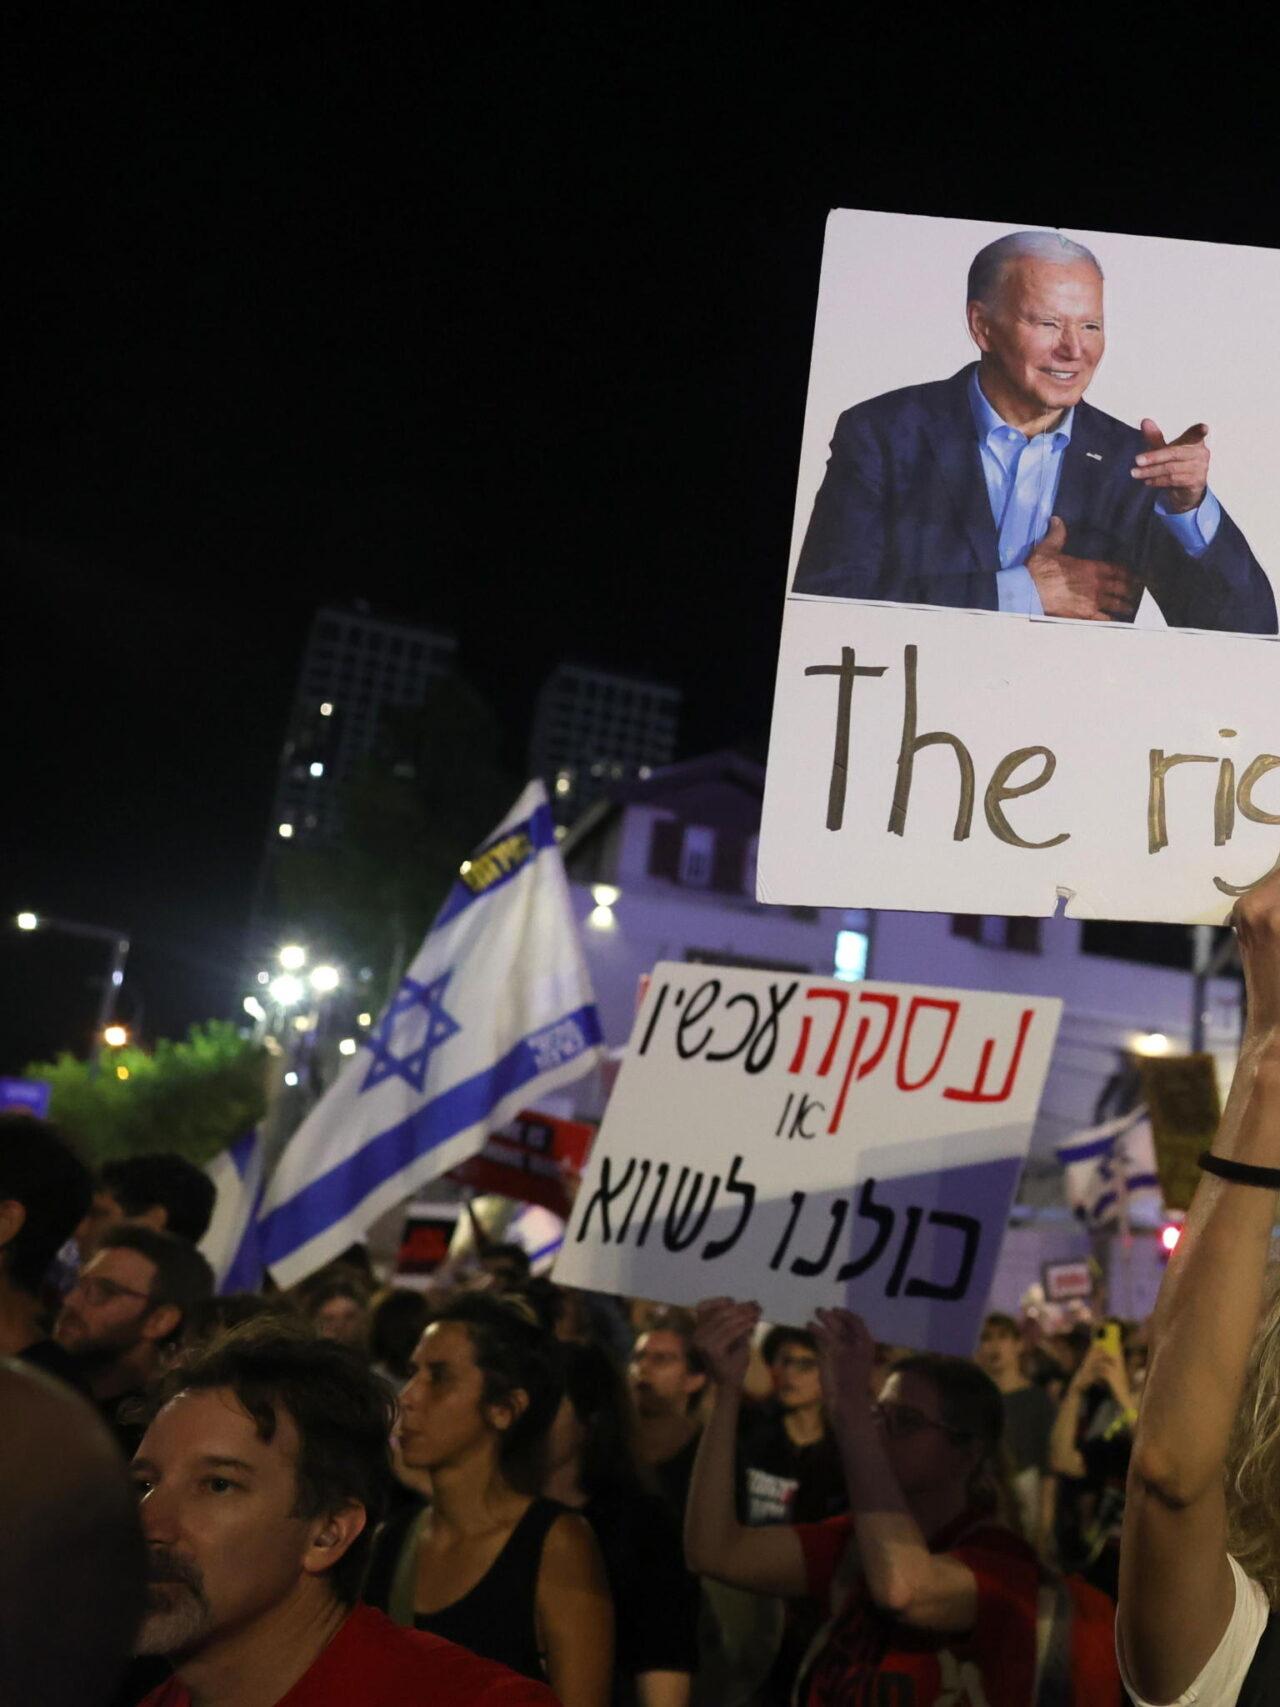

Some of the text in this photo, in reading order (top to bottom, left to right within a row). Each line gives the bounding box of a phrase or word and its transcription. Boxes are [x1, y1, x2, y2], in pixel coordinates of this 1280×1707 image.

[639, 979, 1035, 1134] עסקה עכשיו
[775, 1093, 825, 1139] או
[576, 1155, 756, 1260] לשווא
[769, 1177, 982, 1303] כולנו
